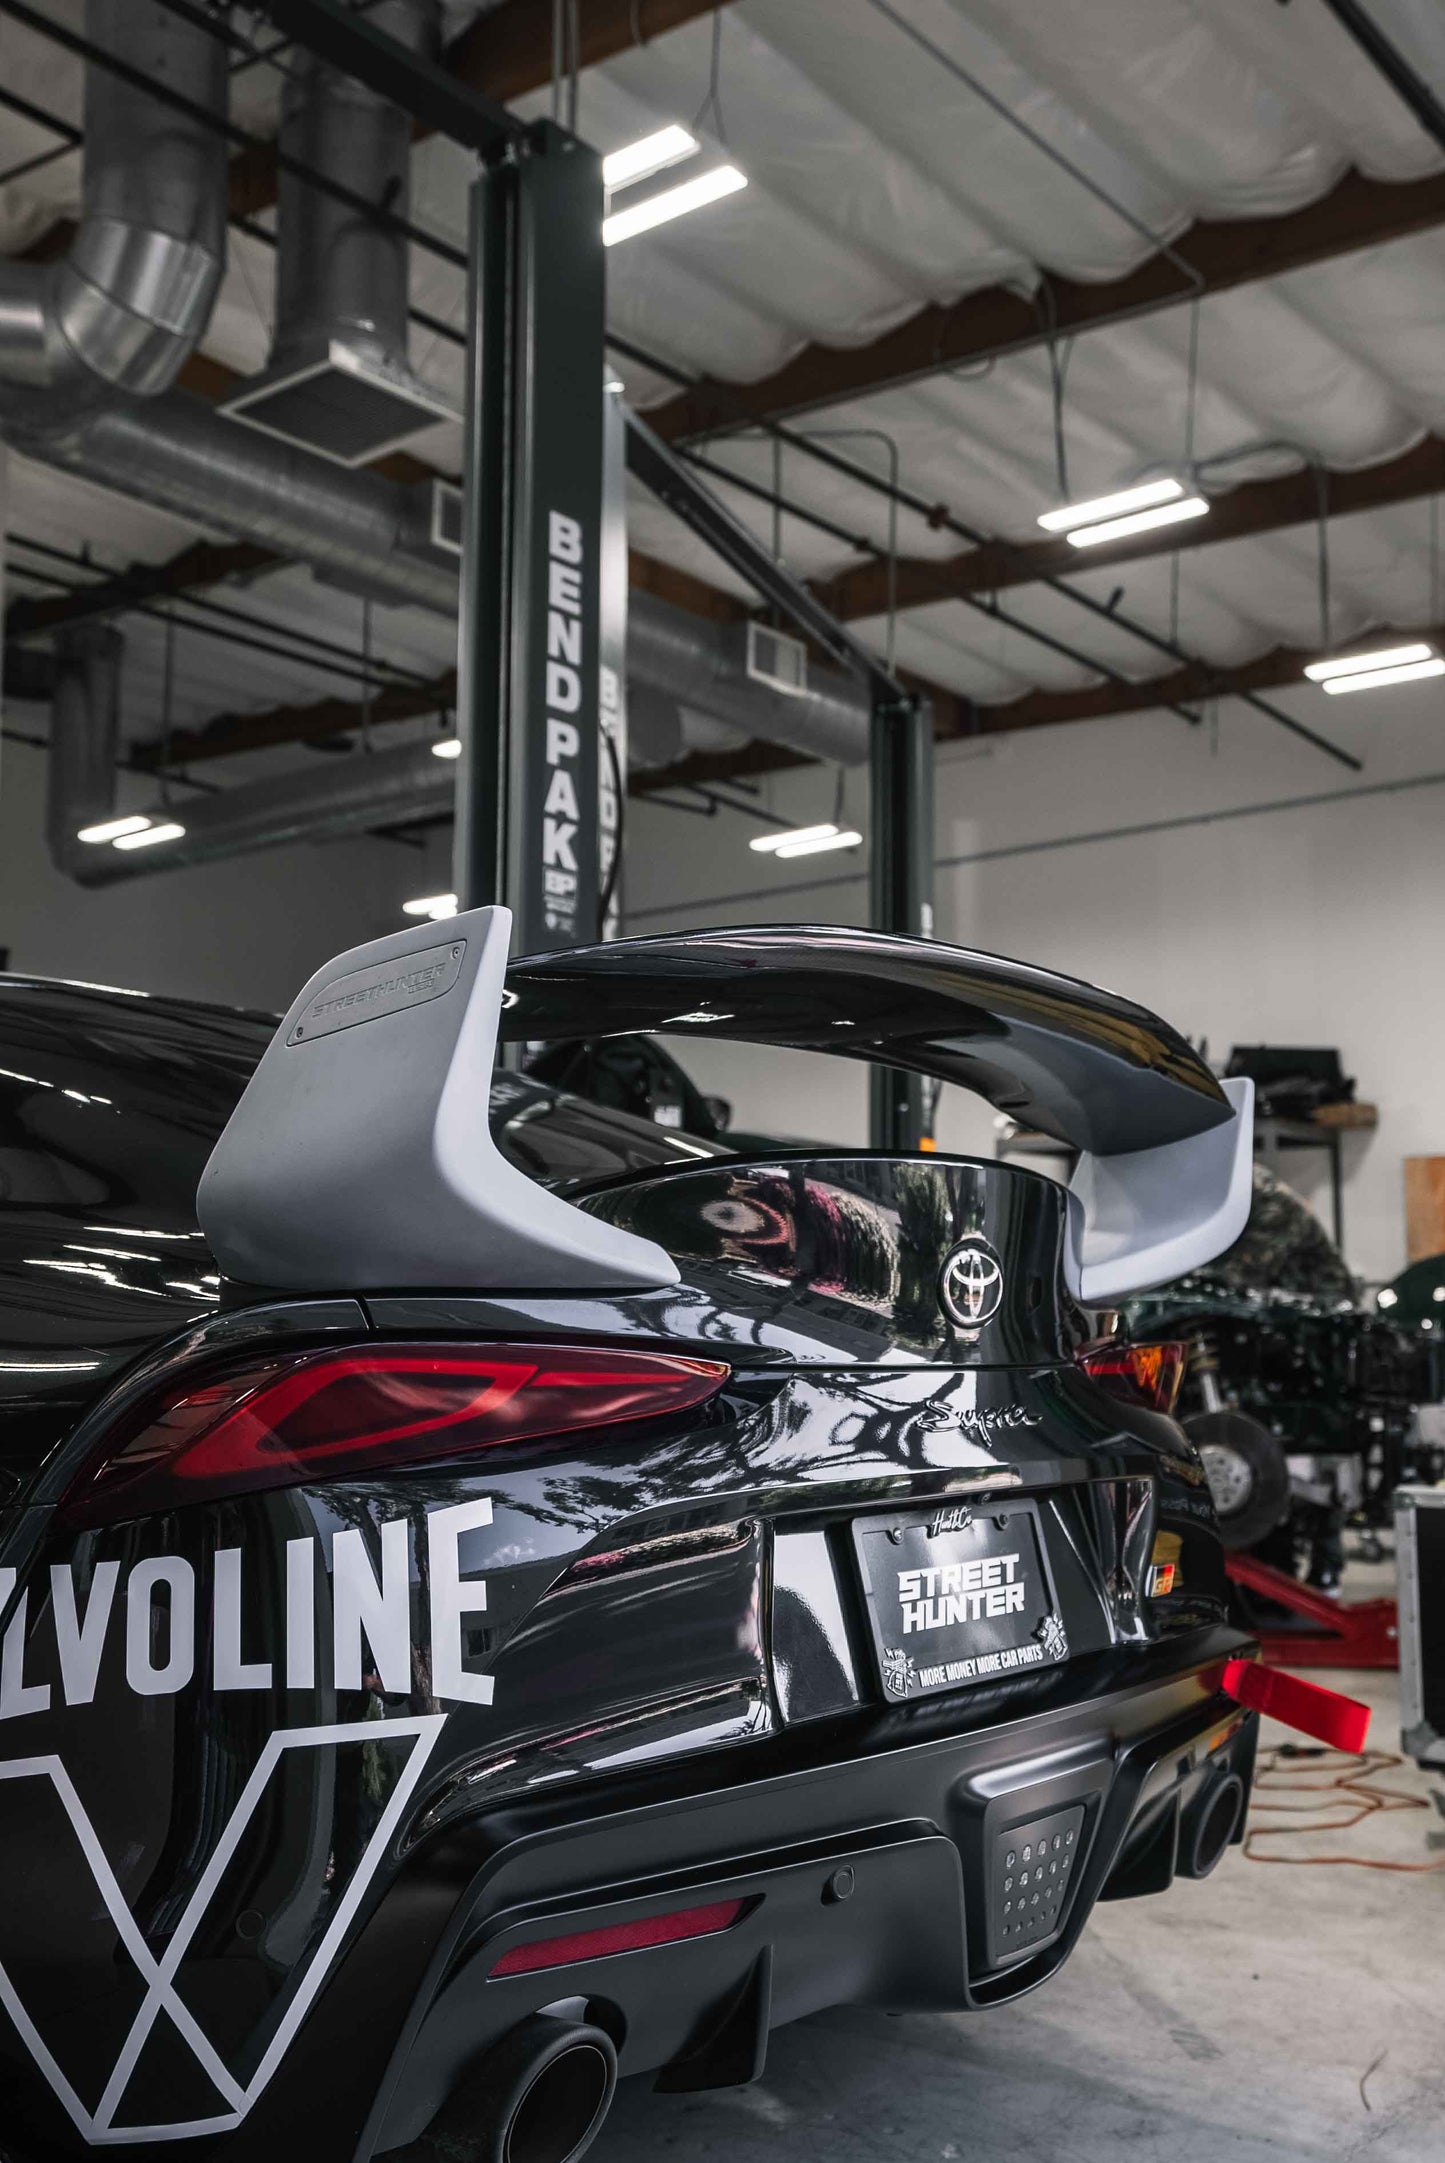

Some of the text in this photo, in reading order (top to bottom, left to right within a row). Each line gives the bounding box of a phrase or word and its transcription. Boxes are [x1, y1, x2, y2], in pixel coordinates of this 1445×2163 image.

[543, 510, 583, 871] BENDPAK
[916, 1399, 1043, 1448] Supra
[897, 1553, 1020, 1603] STREET
[901, 1582, 1025, 1635] HUNTER
[919, 1642, 1043, 1688] MORE MONEY MORE CAR PARTS
